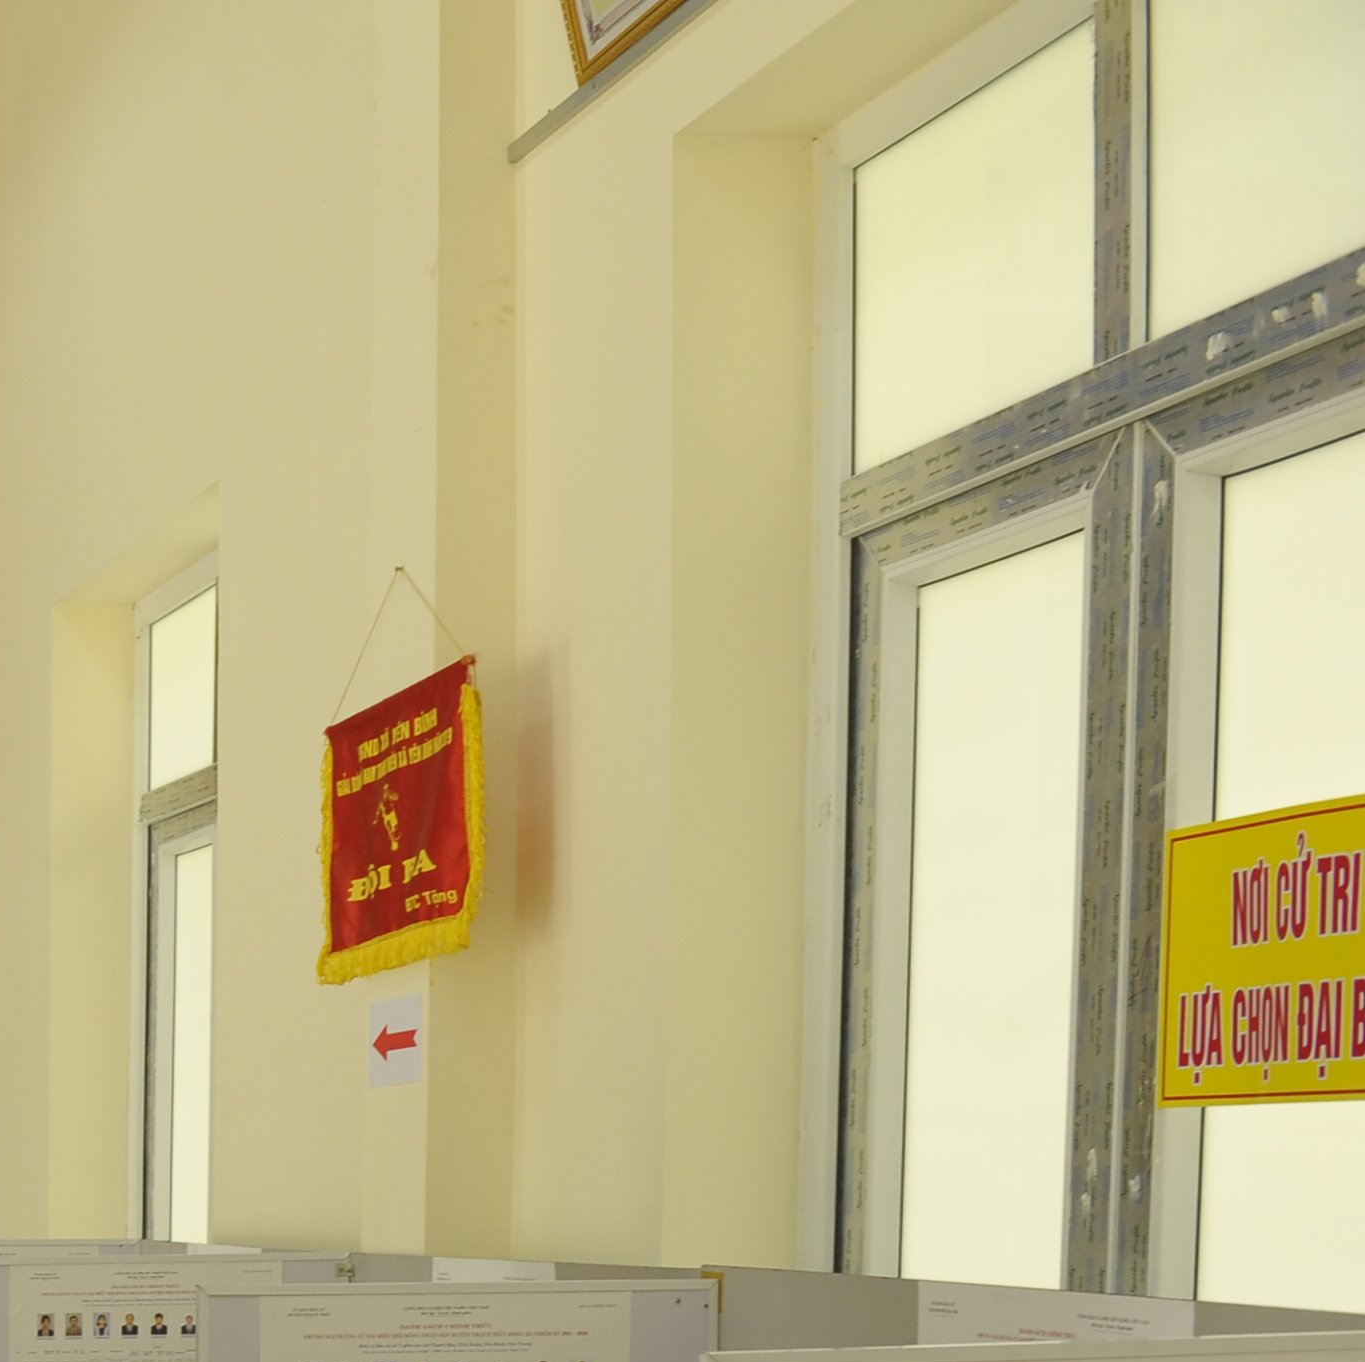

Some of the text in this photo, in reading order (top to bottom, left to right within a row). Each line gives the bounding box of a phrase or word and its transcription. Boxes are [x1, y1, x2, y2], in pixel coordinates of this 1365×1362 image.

[1232, 830, 1362, 946] NƠI CỬ TRI
[1178, 983, 1223, 1084] LỰA
[1232, 984, 1291, 1082] CHỌN
[1297, 978, 1344, 1079] ĐẠI
